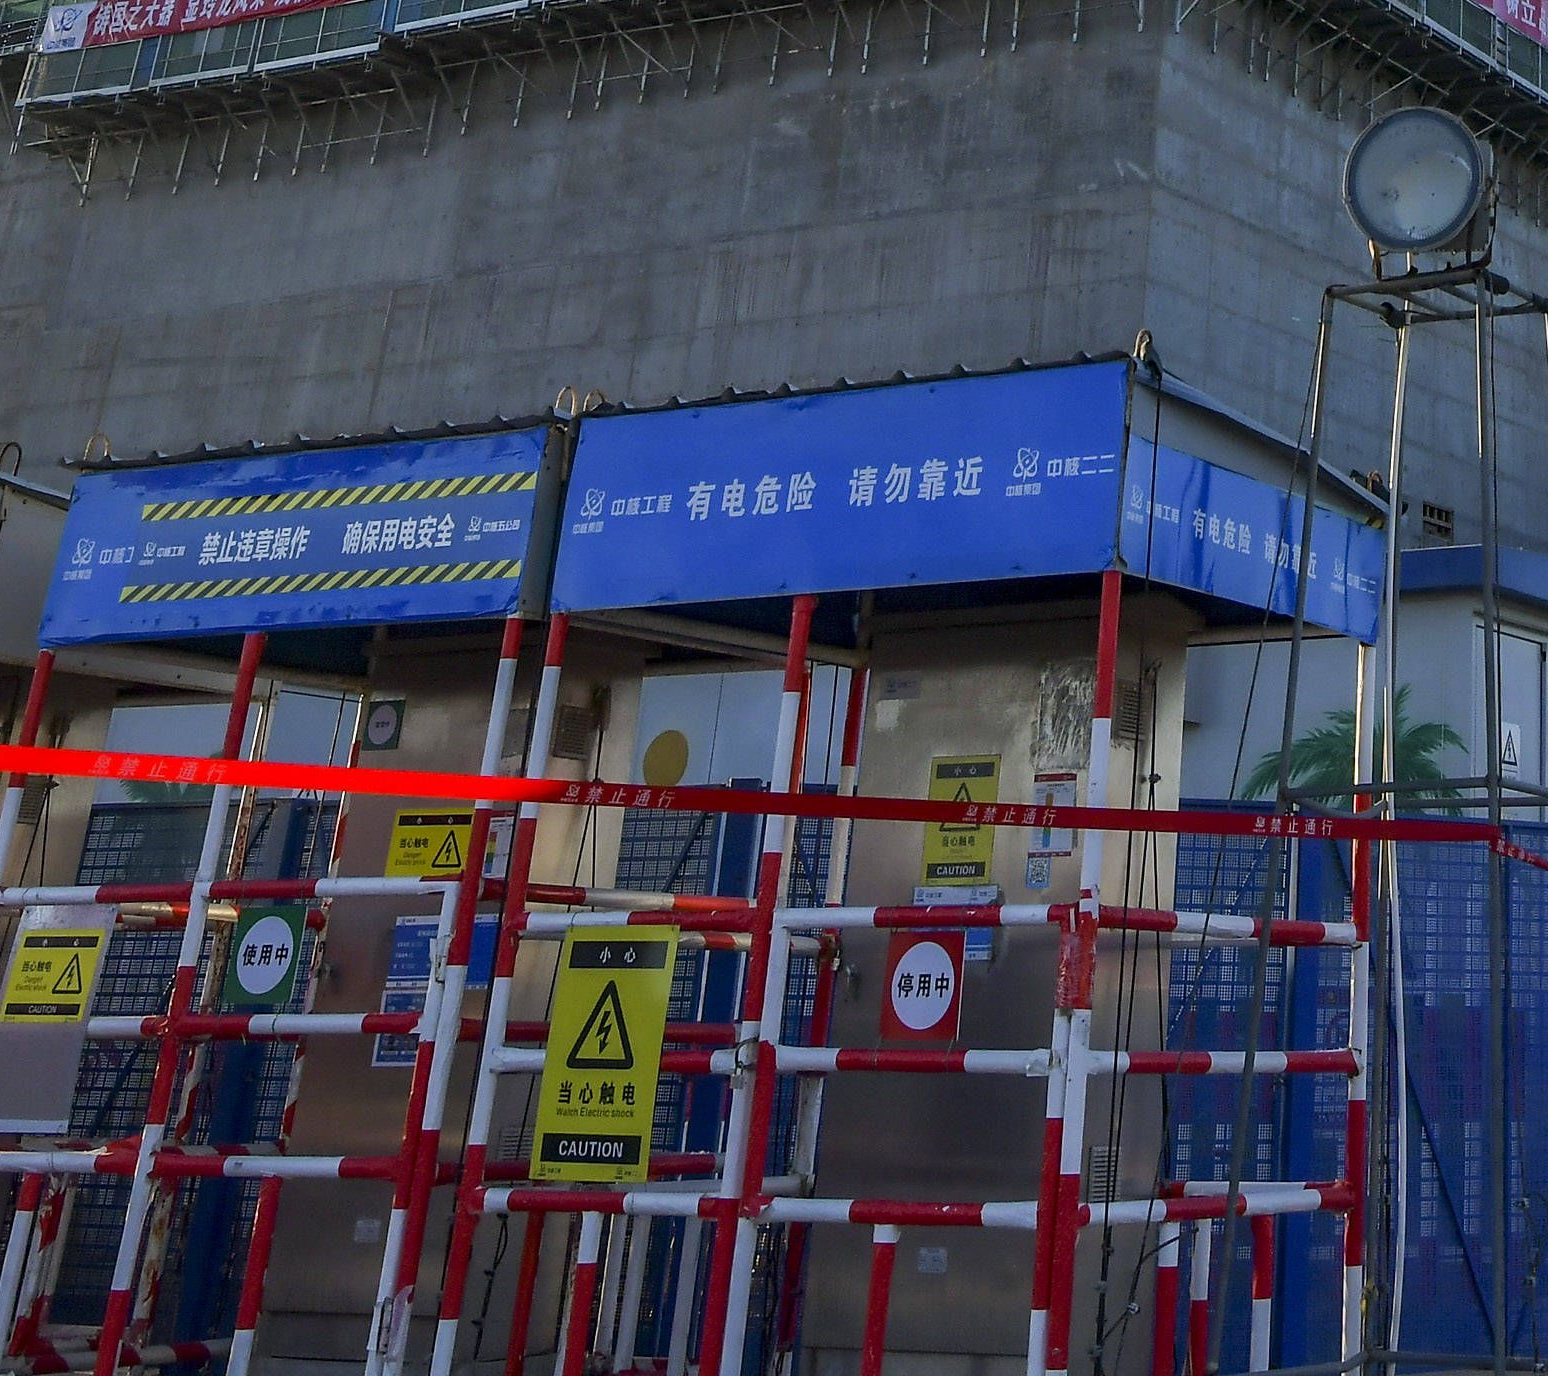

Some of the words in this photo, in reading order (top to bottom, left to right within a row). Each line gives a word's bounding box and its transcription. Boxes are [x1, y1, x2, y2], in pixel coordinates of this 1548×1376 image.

[1046, 453, 1116, 479] 中核二二
[610, 493, 673, 517] 中核工程
[685, 471, 818, 522] 有电危险
[848, 455, 983, 508] 请勿靠近
[197, 527, 312, 567] 禁止违章操作
[339, 512, 456, 554] 确保用电安全
[1192, 508, 1252, 556] 有电危险
[117, 756, 228, 783] 禁止通行
[584, 785, 677, 809] 禁止通行
[981, 804, 1058, 827] 禁止通行
[1268, 814, 1334, 837] 禁止通行
[936, 864, 977, 876] CAUTION
[242, 943, 289, 967] 使用中
[599, 946, 637, 964] 小心
[897, 972, 951, 999] 停用中
[28, 1005, 58, 1014] CAUTION
[557, 1079, 636, 1106] 当心触电
[579, 1107, 610, 1118] Electric
[610, 1108, 635, 1119] shock
[557, 1139, 624, 1159] CAUTION
